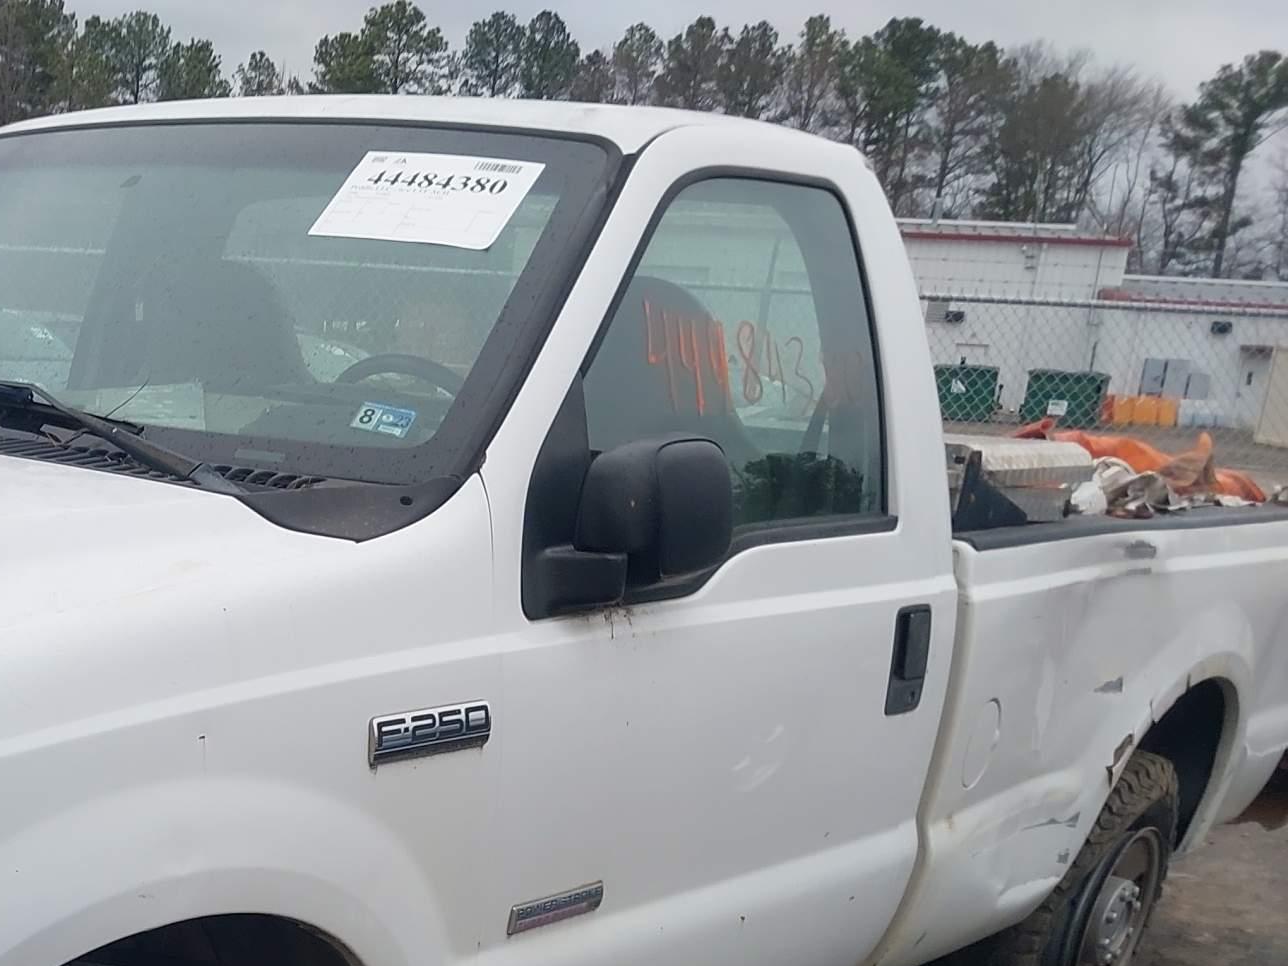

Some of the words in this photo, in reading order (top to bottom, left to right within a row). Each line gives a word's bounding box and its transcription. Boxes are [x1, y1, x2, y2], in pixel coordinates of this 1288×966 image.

[367, 170, 508, 195] 44484380
[359, 408, 376, 424] 8
[377, 704, 492, 749] F-250
